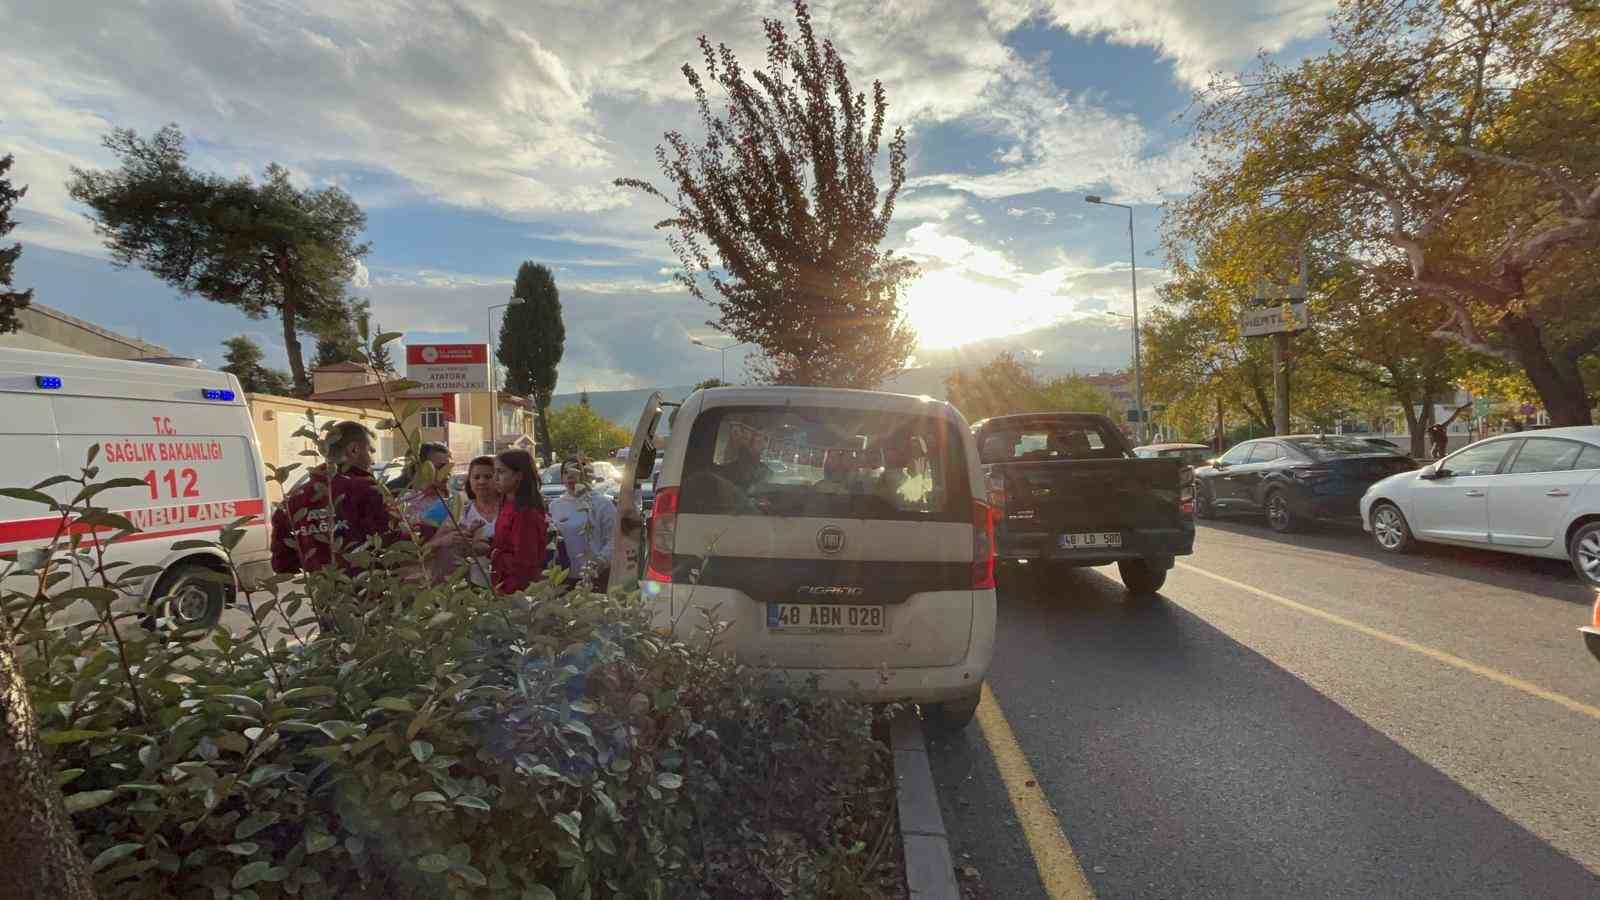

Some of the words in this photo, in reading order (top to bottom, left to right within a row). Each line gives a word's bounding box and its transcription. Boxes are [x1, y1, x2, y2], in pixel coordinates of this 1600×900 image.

[152, 416, 177, 435] T.C.
[104, 440, 157, 463] SAĞLIK
[159, 440, 223, 461] BAKANLIĞI
[144, 468, 199, 500] 112
[116, 501, 236, 529] MBULANS
[778, 606, 801, 625] 48
[809, 606, 841, 625] ABN
[848, 607, 881, 626] 028
